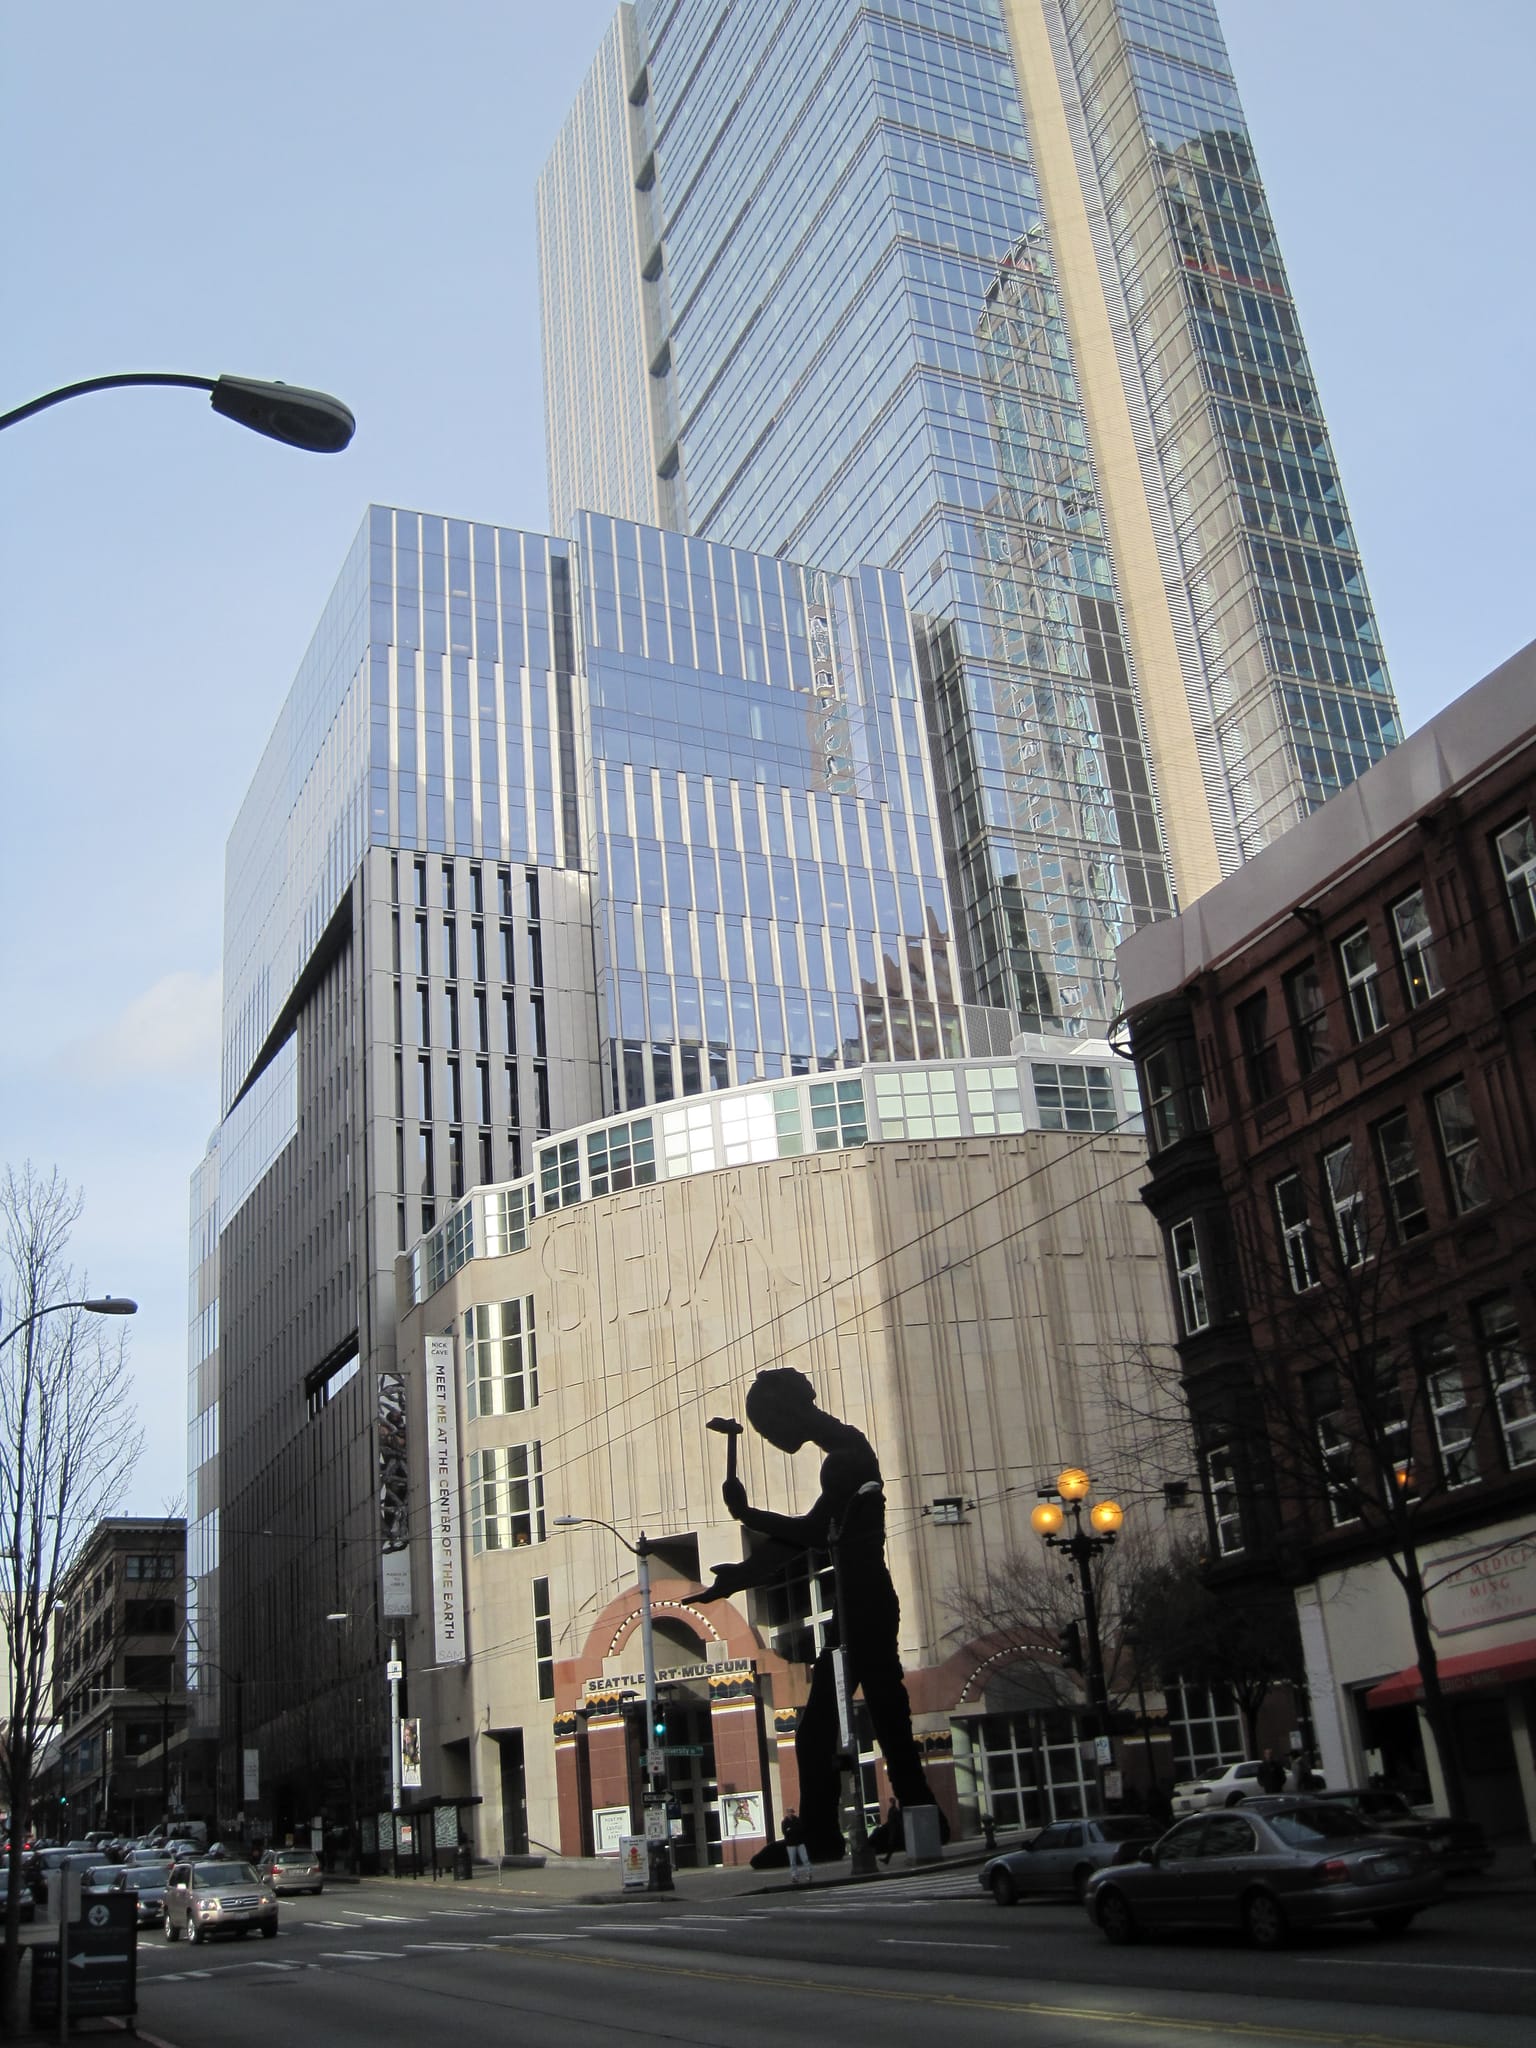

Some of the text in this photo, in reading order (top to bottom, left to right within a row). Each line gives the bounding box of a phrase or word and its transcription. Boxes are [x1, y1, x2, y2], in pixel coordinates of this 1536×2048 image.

[436, 1365, 455, 1640] MEET ME AT THE CENTER OF THE EARTH
[439, 1648, 463, 1661] SAM
[588, 1673, 646, 1690] SEATTLE
[682, 1659, 748, 1677] MUSEUM
